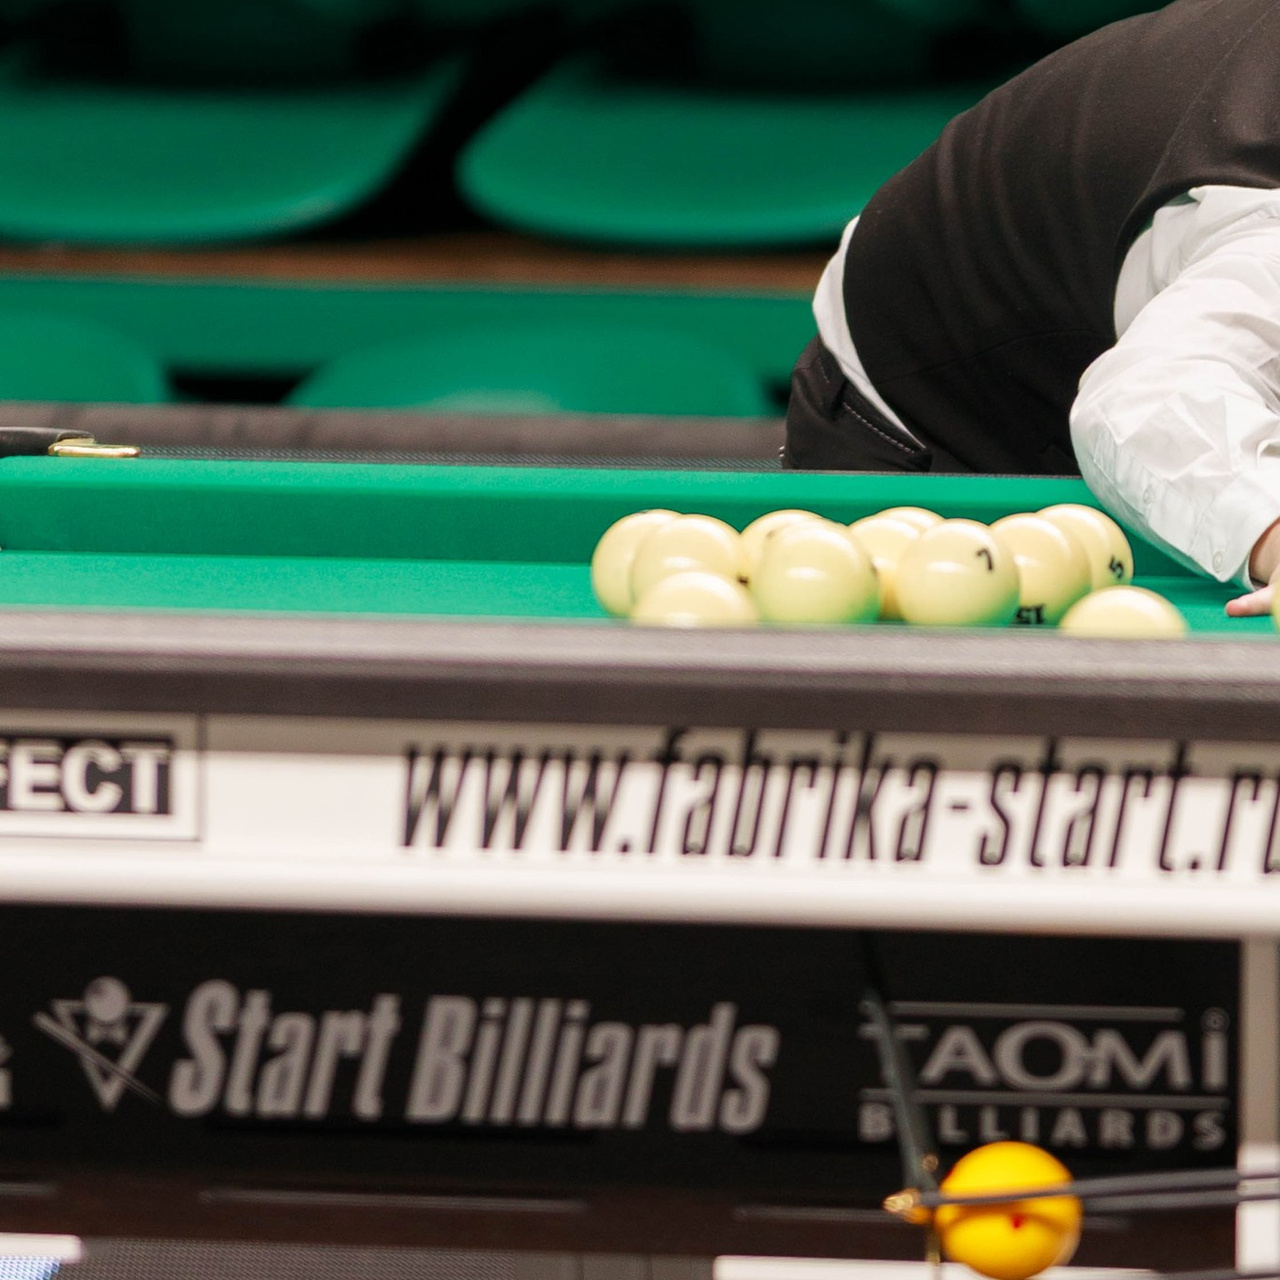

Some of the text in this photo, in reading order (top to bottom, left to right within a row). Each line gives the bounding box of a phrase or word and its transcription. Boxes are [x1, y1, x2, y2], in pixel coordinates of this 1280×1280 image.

[975, 548, 994, 572] 7
[1108, 554, 1125, 581] 5
[167, 978, 781, 1134] Start Billiards
[857, 1102, 1228, 1151] BLLIARDS
